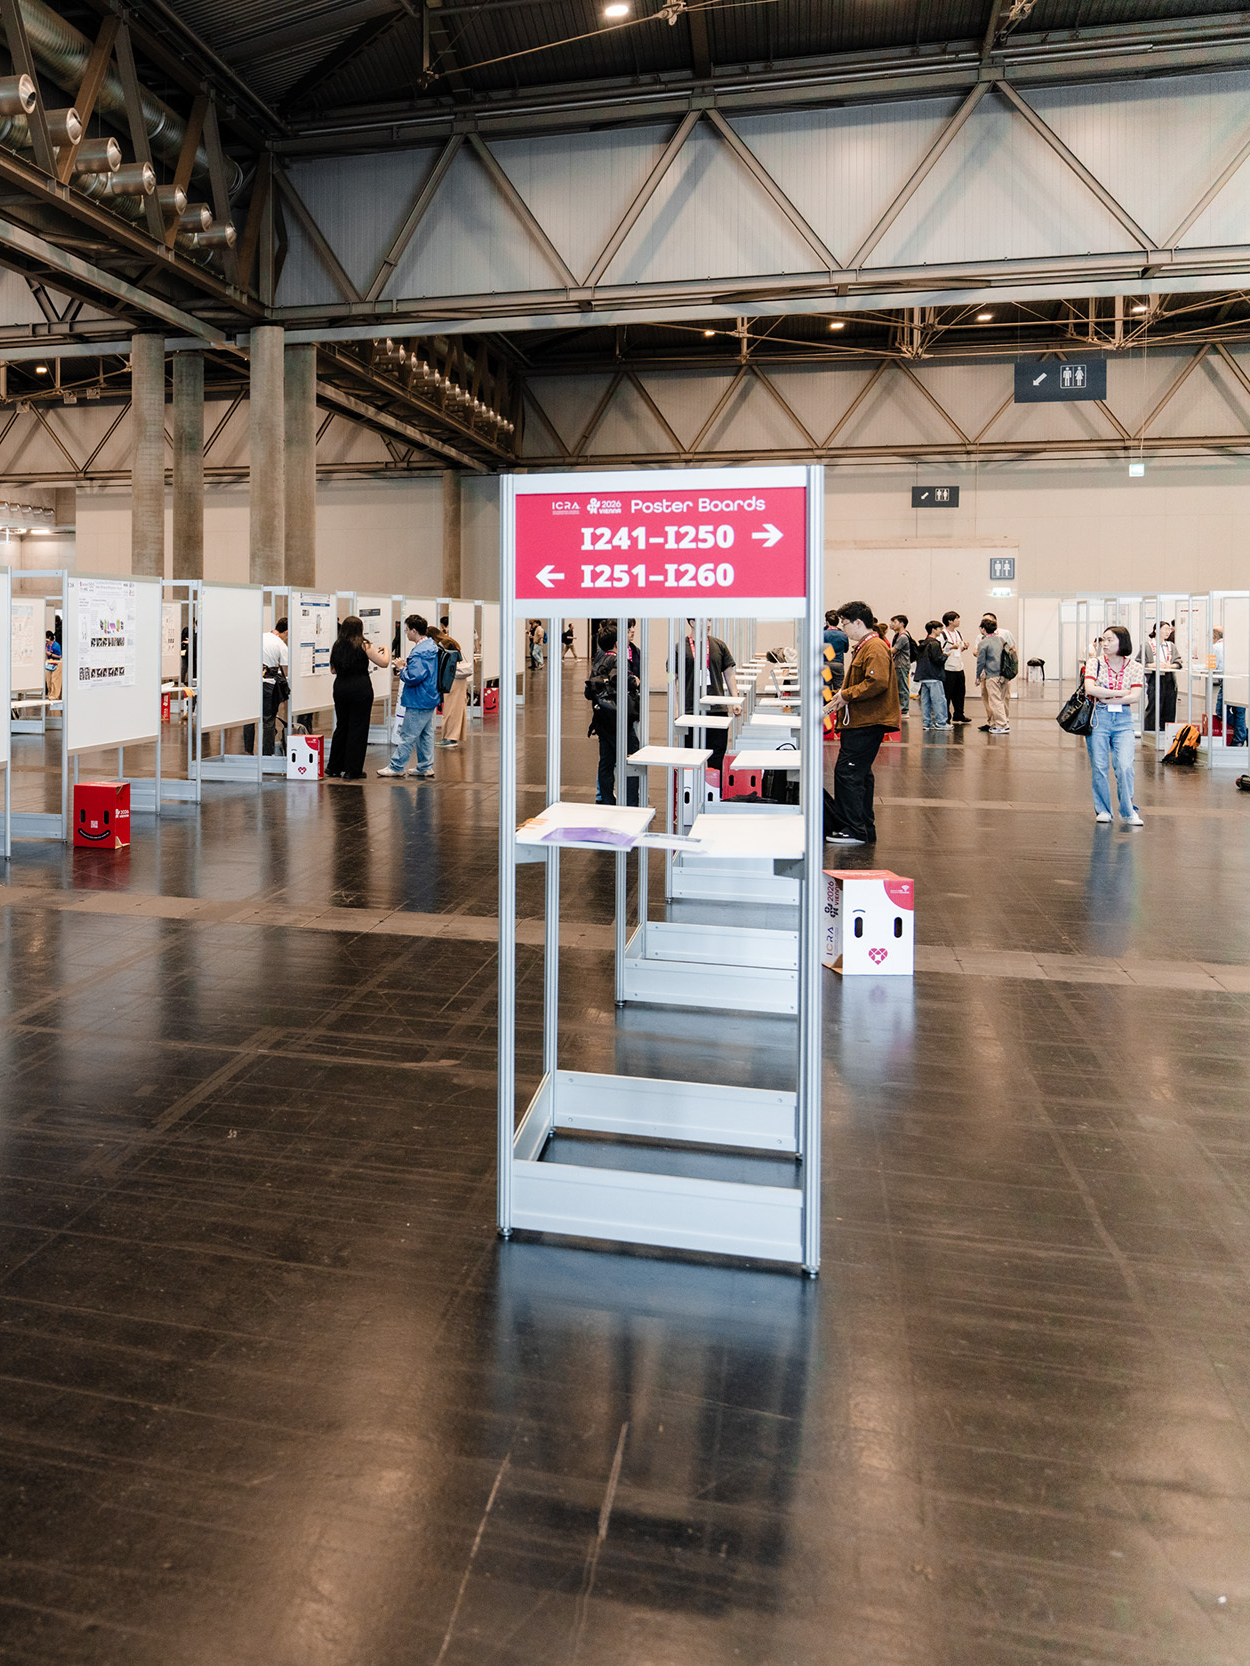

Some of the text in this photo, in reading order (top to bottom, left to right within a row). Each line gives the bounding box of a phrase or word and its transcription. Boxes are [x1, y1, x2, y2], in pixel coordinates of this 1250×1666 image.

[552, 501, 580, 510] ICRA
[601, 500, 622, 508] 2026
[631, 495, 766, 514] Poster Boards
[581, 524, 735, 550] I241-I250
[581, 562, 735, 588] I251-I260
[826, 926, 834, 955] ICRA
